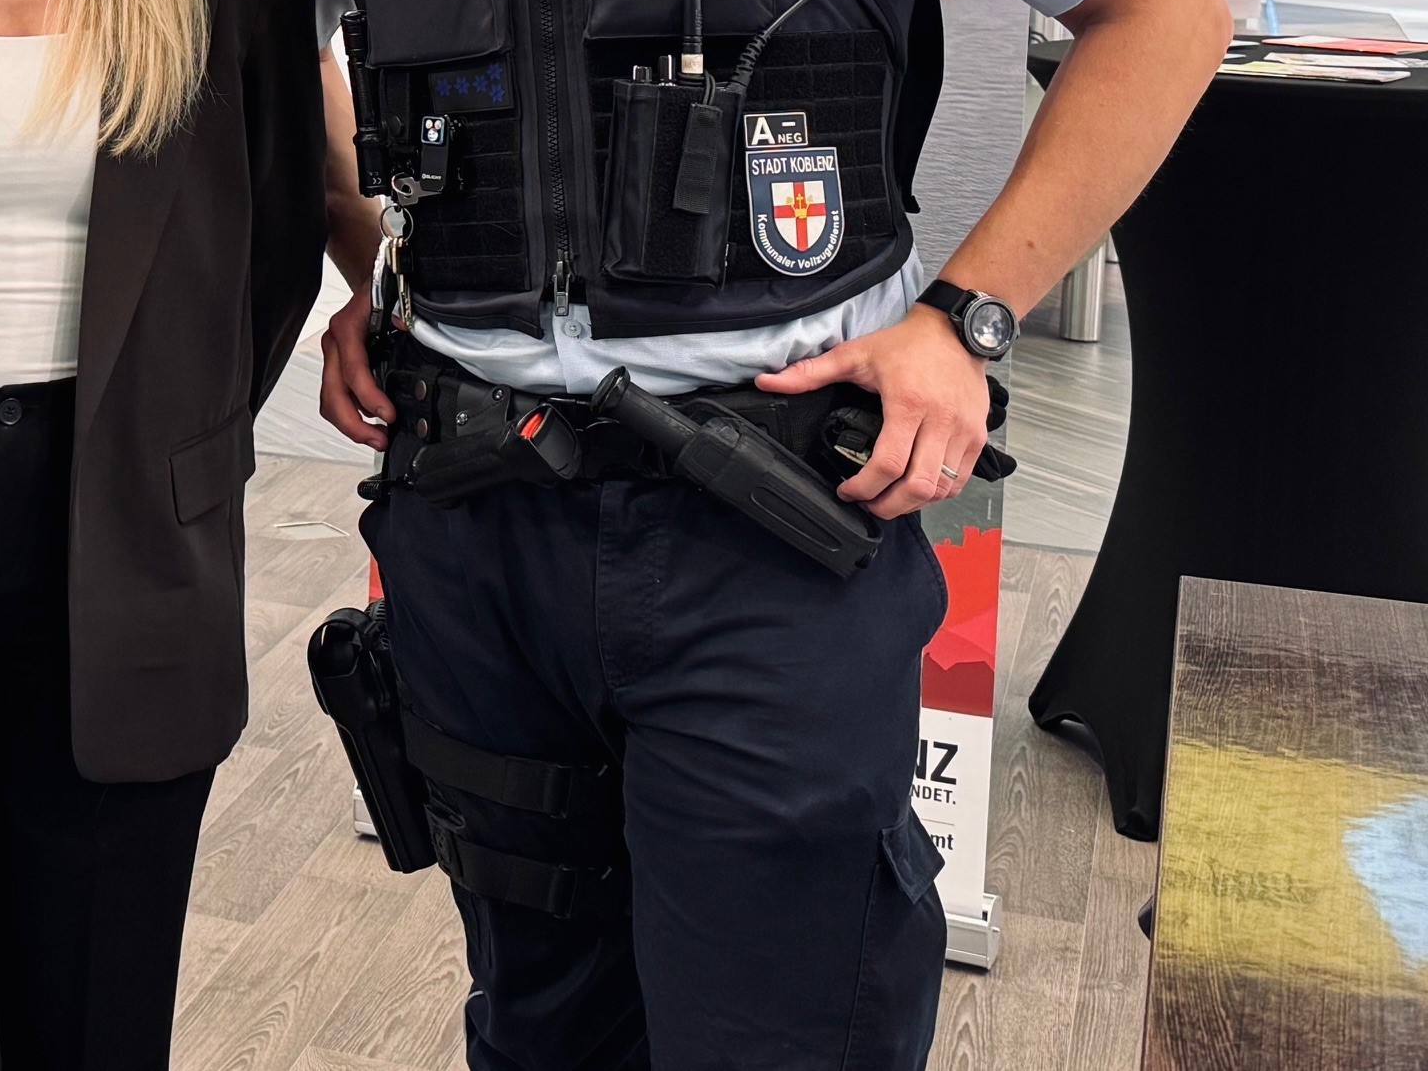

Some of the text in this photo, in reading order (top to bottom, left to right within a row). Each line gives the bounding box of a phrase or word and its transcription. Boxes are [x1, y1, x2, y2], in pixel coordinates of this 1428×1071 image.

[777, 132, 803, 144] NEG
[751, 155, 836, 176] STADT KOBLENZ
[757, 213, 796, 269] Kommunaler
[797, 209, 840, 270] Vollzugsdienst
